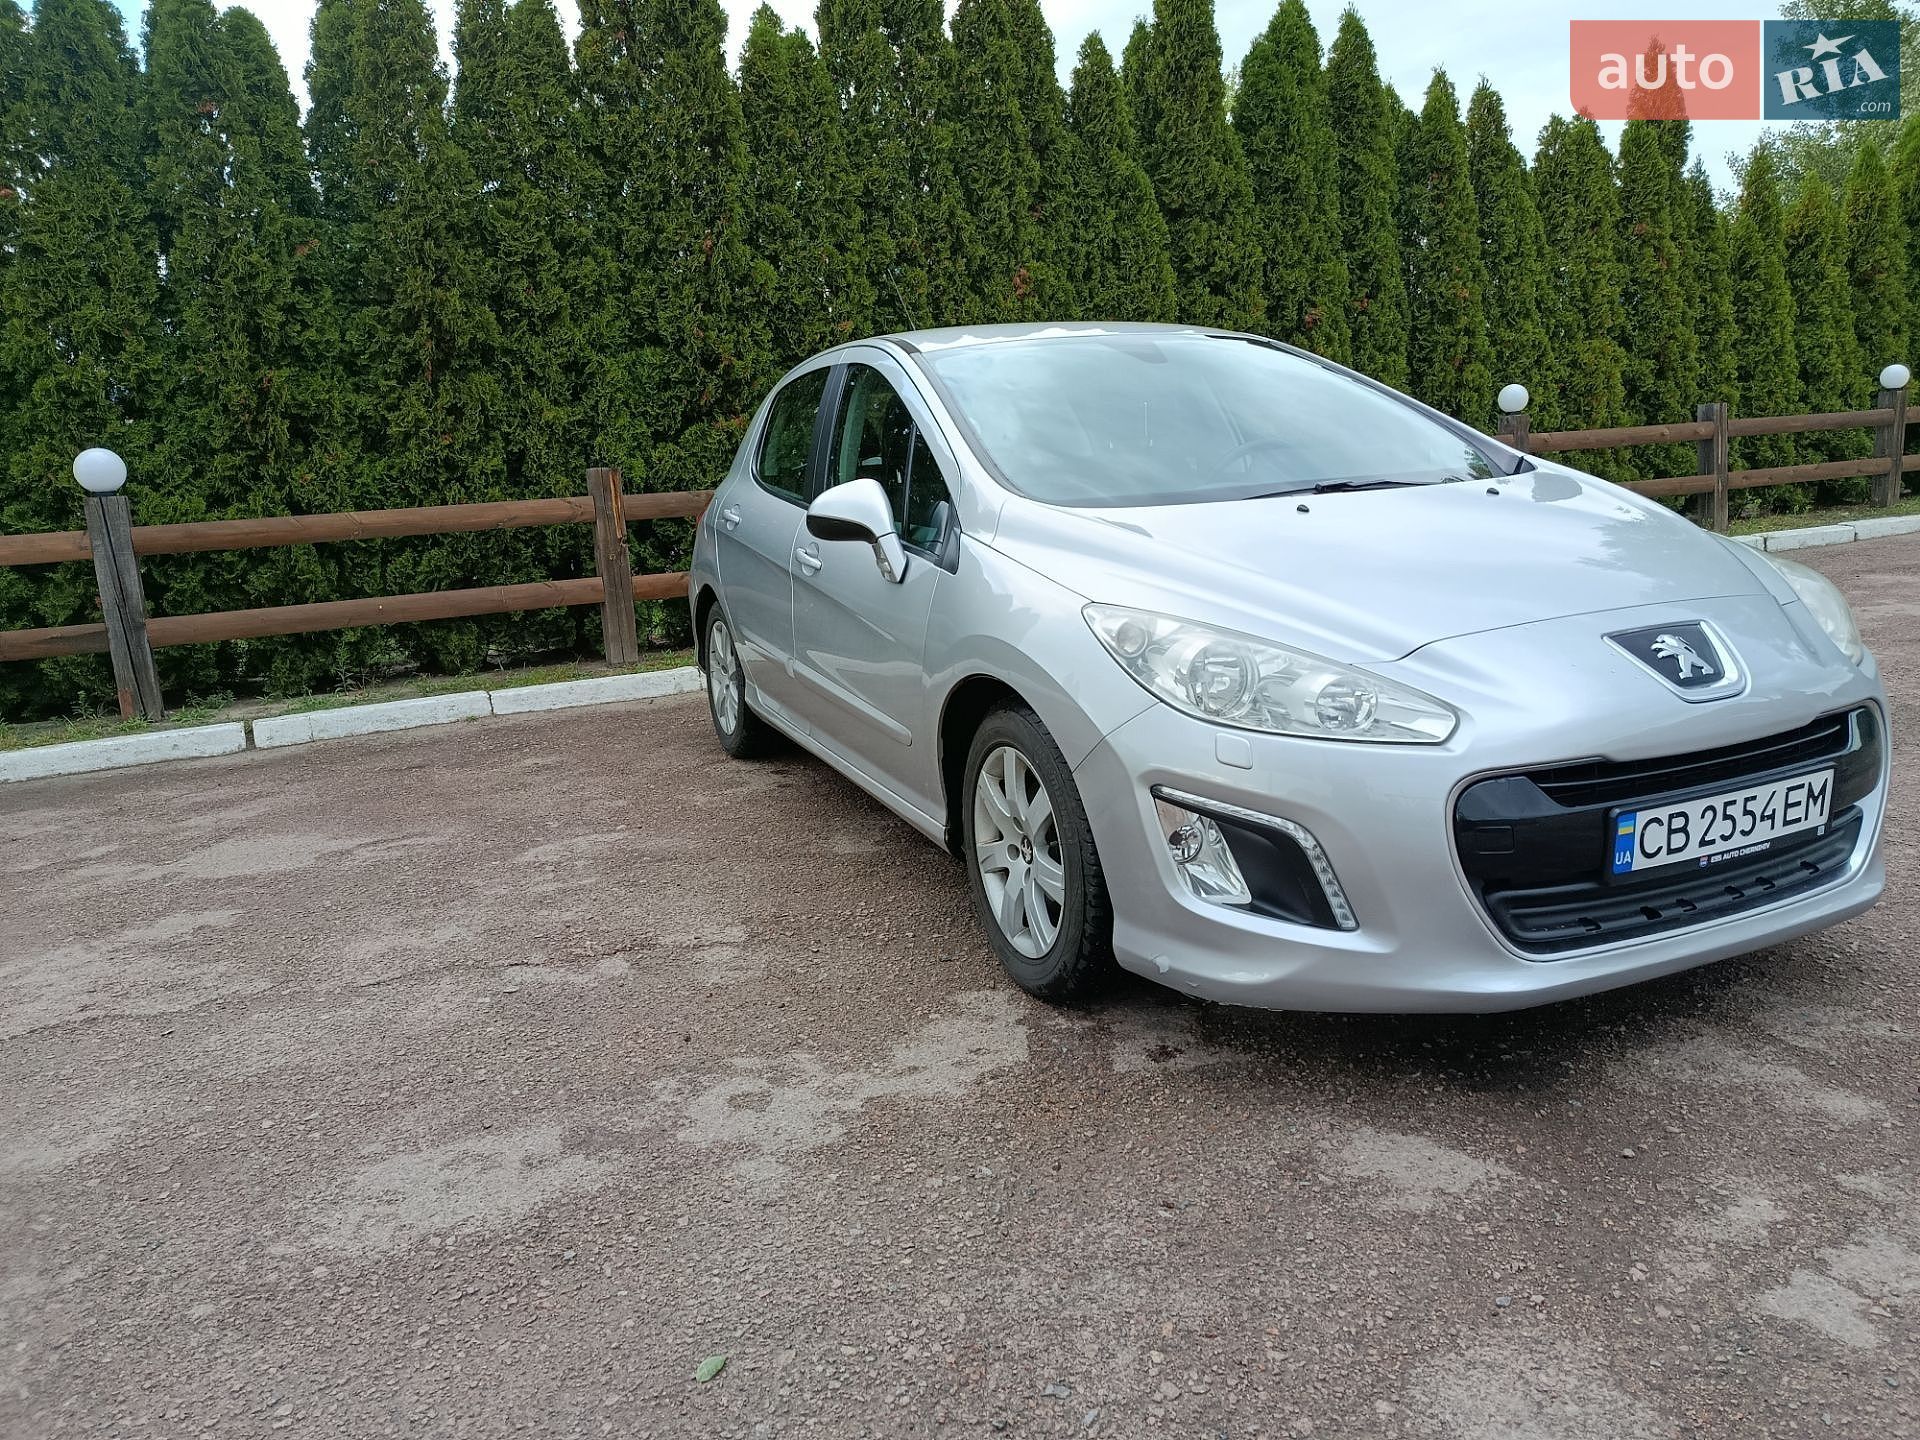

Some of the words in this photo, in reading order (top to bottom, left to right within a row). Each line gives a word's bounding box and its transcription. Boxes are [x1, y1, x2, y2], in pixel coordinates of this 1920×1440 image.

[1639, 810, 1690, 859] CB
[1615, 851, 1631, 865] UA
[1723, 849, 1739, 861] AUTO
